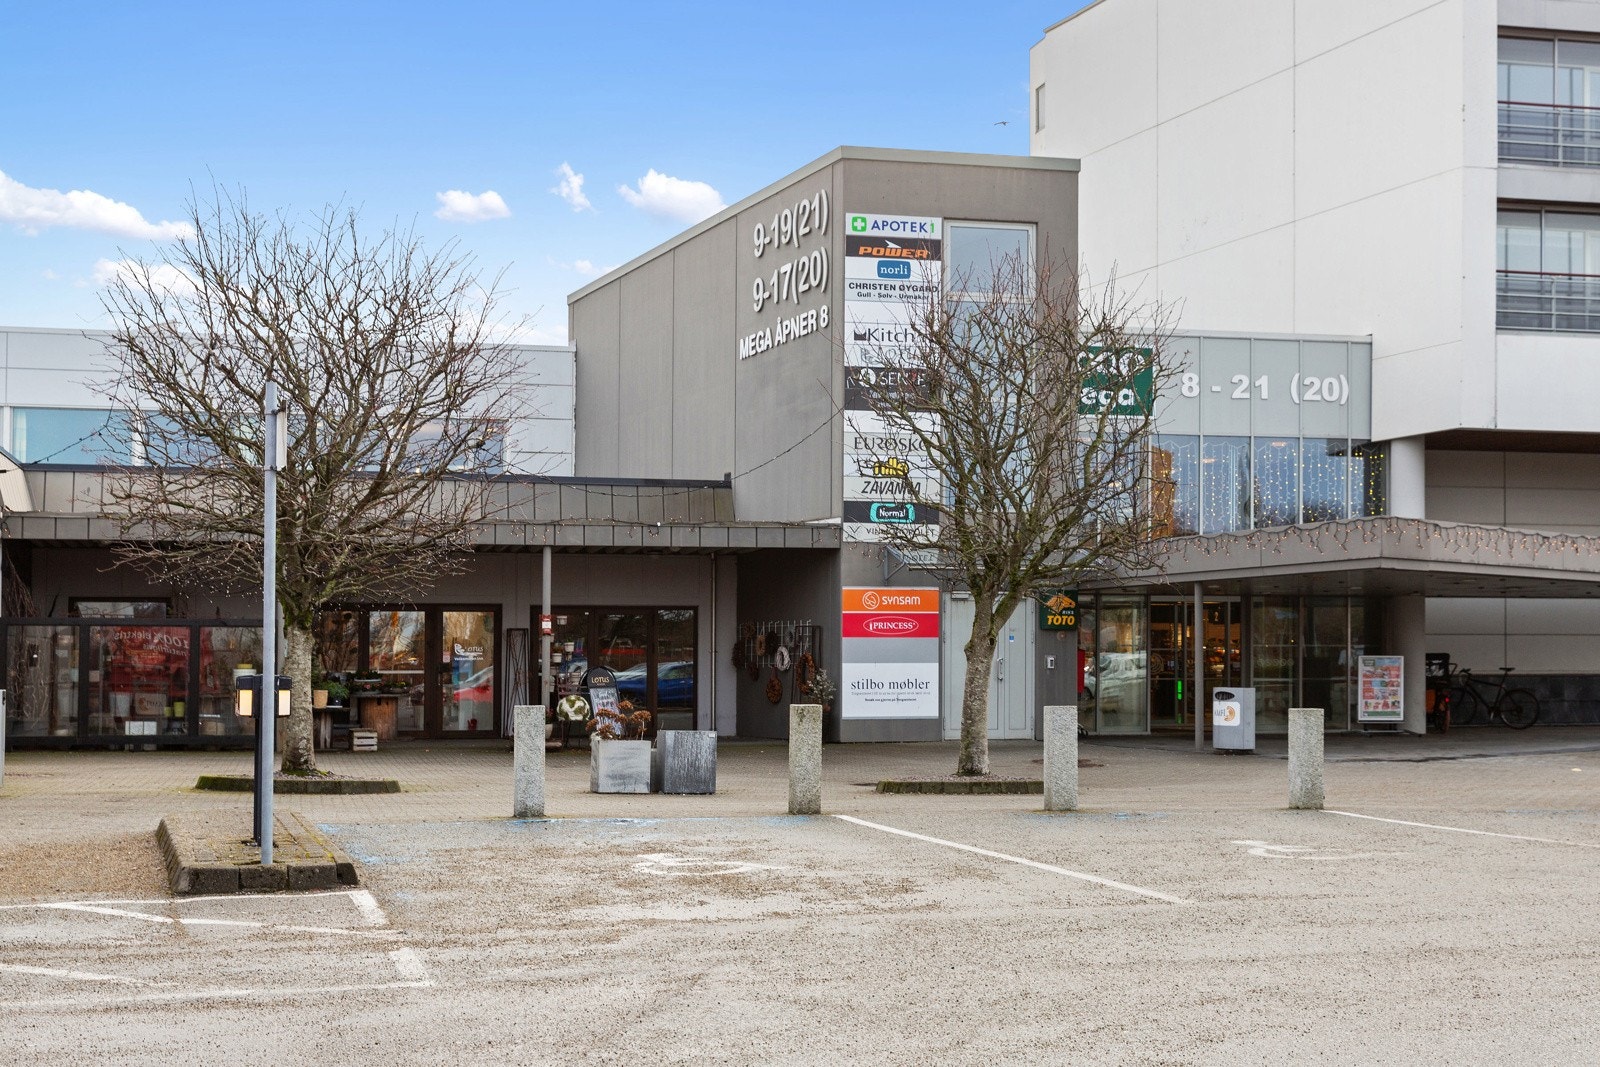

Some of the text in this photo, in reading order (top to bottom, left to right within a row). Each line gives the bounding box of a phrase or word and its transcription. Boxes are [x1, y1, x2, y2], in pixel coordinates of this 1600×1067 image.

[753, 189, 829, 258] 9-19(21)
[871, 220, 935, 233] APOTEK 1
[858, 246, 929, 259] POWER
[880, 264, 908, 275] norli
[753, 246, 829, 312] 9-17(20)
[848, 282, 896, 292] CHRISTEN
[739, 304, 829, 360] MEGA ÅPNER 8
[867, 328, 916, 343] Kitch
[1181, 372, 1200, 398] 8
[1231, 374, 1269, 400] 21
[1290, 372, 1350, 405] (20)
[879, 508, 906, 517] Normal
[881, 596, 921, 605] SYNSAM
[873, 622, 913, 630] PRINCESS
[1046, 615, 1076, 626] TOTO
[591, 676, 610, 684] LOTUS
[851, 678, 931, 690] stilbo møbler
